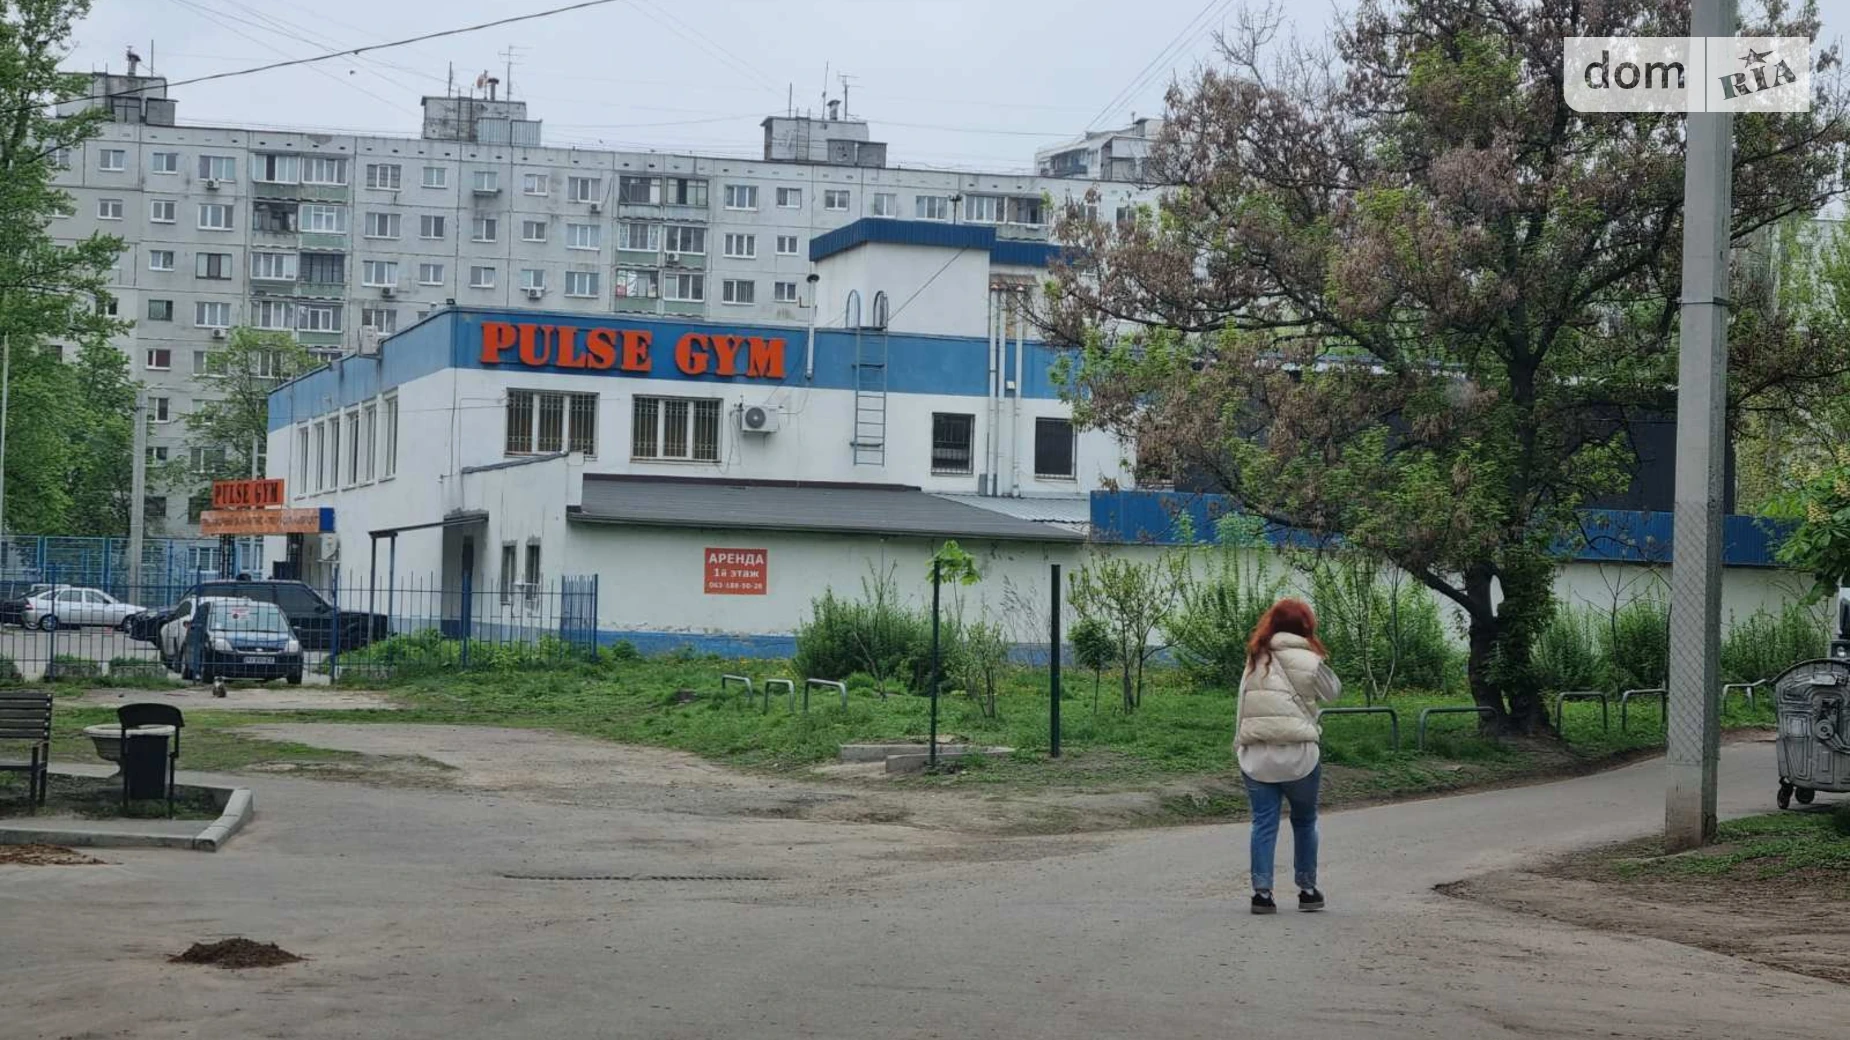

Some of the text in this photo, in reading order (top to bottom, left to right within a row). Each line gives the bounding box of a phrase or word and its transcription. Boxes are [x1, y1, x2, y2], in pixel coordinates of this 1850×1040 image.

[480, 321, 787, 379] PULSE GYM
[214, 482, 278, 504] PULSE GYM
[709, 553, 764, 566] АРЕНДА
